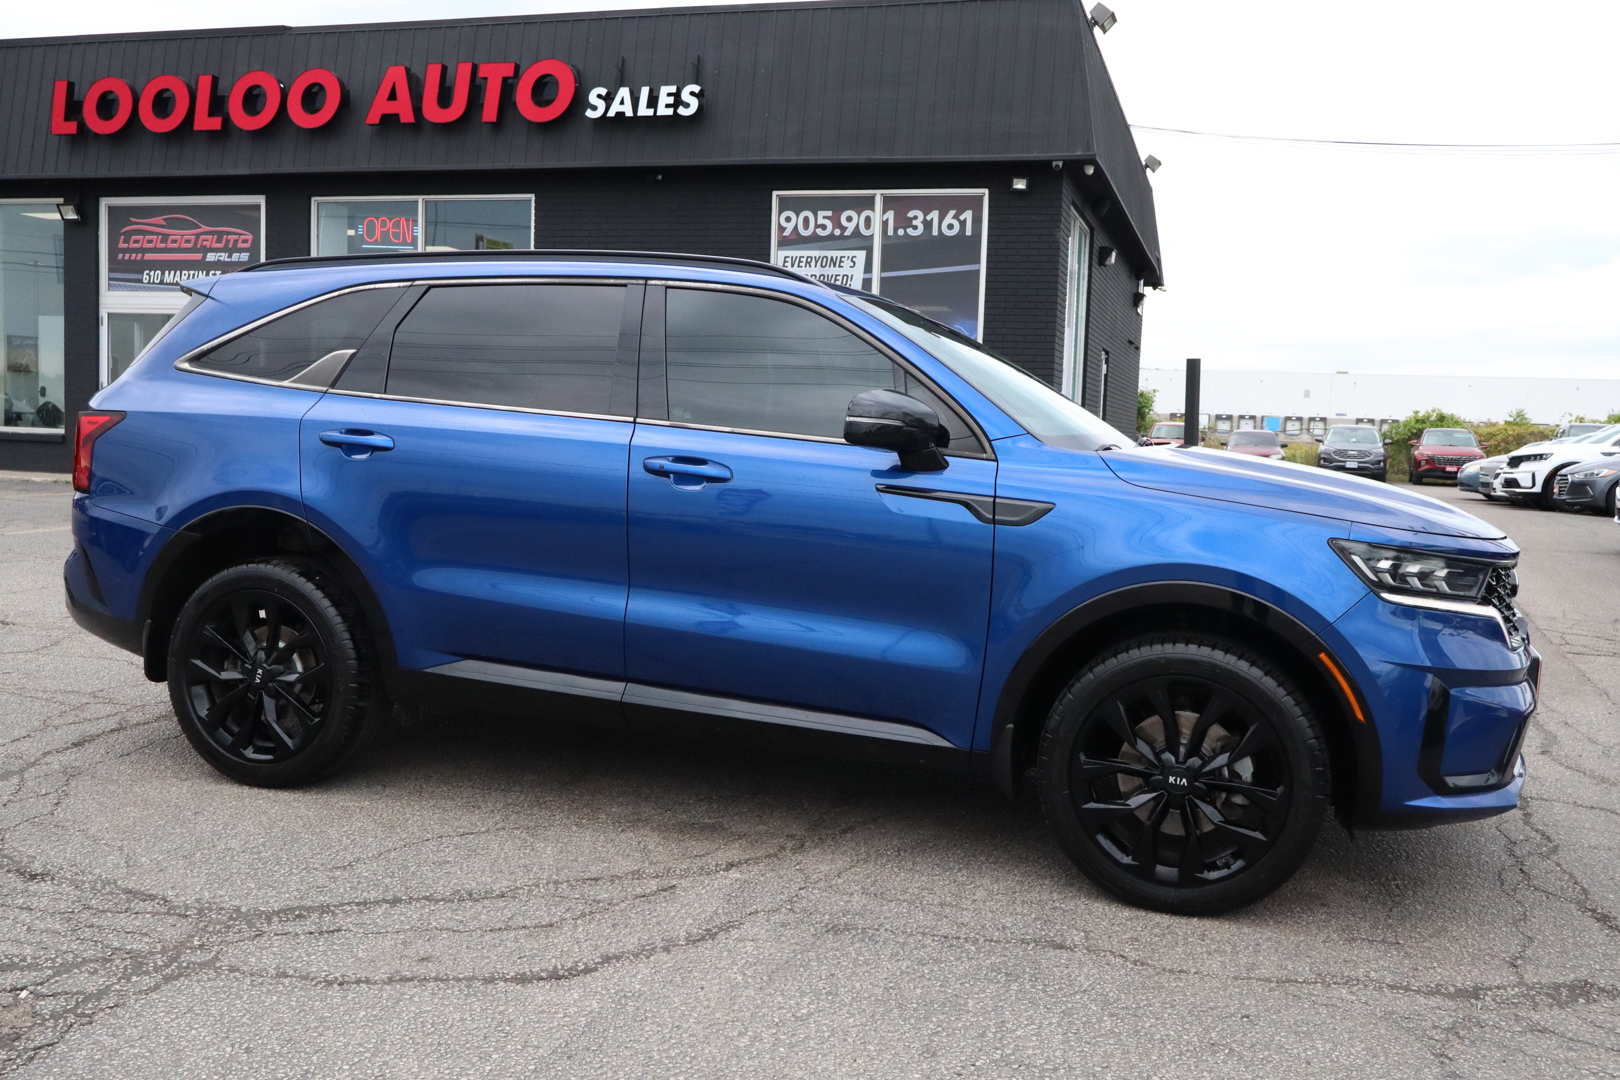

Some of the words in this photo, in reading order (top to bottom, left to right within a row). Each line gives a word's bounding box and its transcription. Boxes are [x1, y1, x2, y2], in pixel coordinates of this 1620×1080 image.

[51, 68, 341, 134] LOOLOO
[364, 58, 576, 124] AUTO
[584, 84, 701, 119] SALES
[363, 216, 413, 243] OPEN
[779, 209, 973, 237] 905.901.3161
[118, 235, 196, 249] LOOLOO
[197, 235, 254, 249] AUTO
[205, 252, 250, 262] SALES
[782, 255, 858, 269] EVERYONE'S
[142, 270, 162, 284] 610
[254, 668, 264, 683] KIA
[1168, 775, 1188, 787] KIA
